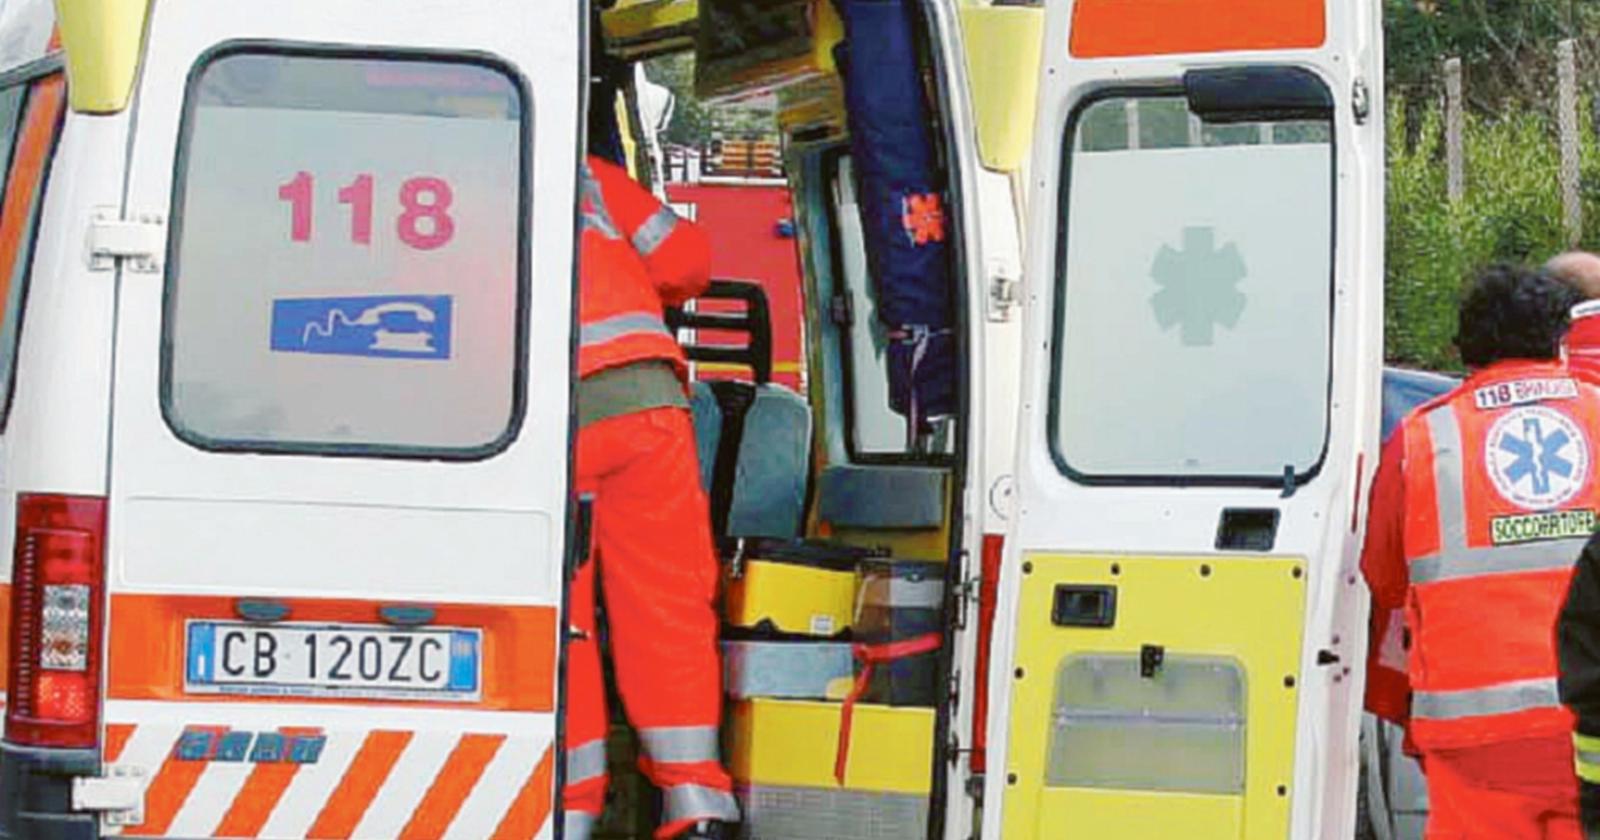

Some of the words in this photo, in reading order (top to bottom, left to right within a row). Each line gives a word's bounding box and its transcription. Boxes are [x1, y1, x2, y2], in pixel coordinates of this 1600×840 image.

[278, 171, 455, 250] 118
[1477, 384, 1512, 406] 118
[222, 630, 278, 678] CB
[304, 633, 443, 683] 120ZC
